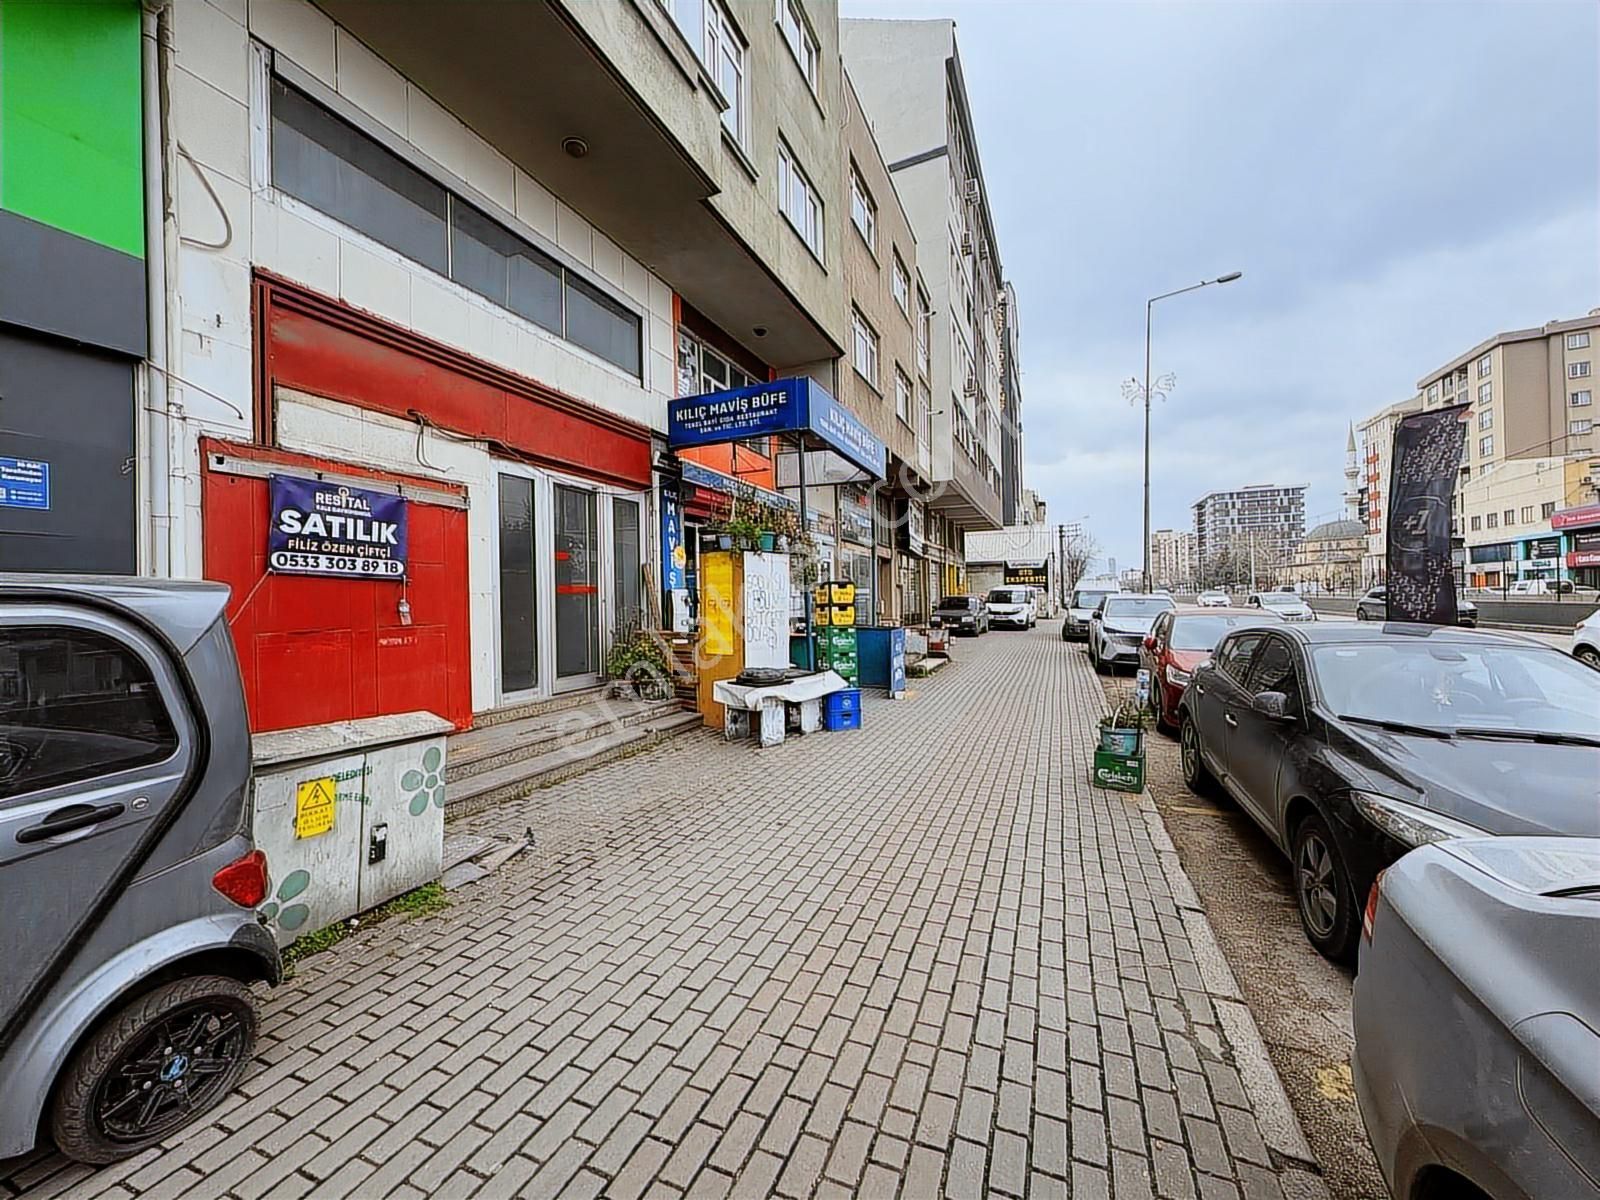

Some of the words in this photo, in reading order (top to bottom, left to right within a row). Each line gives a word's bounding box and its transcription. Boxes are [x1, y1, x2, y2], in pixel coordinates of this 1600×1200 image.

[676, 407, 707, 422] KILIÇ
[709, 397, 749, 415] MAVİŞ
[752, 392, 787, 409] BÜFE
[279, 509, 398, 545] SATILIK
[288, 537, 319, 551] FİLİZ
[321, 540, 354, 555] ÖZEN
[357, 544, 391, 559] ÇİFTÇİ
[276, 553, 321, 569] 0533
[325, 556, 357, 571] 303
[361, 560, 379, 572] 89
[383, 562, 399, 574] 18
